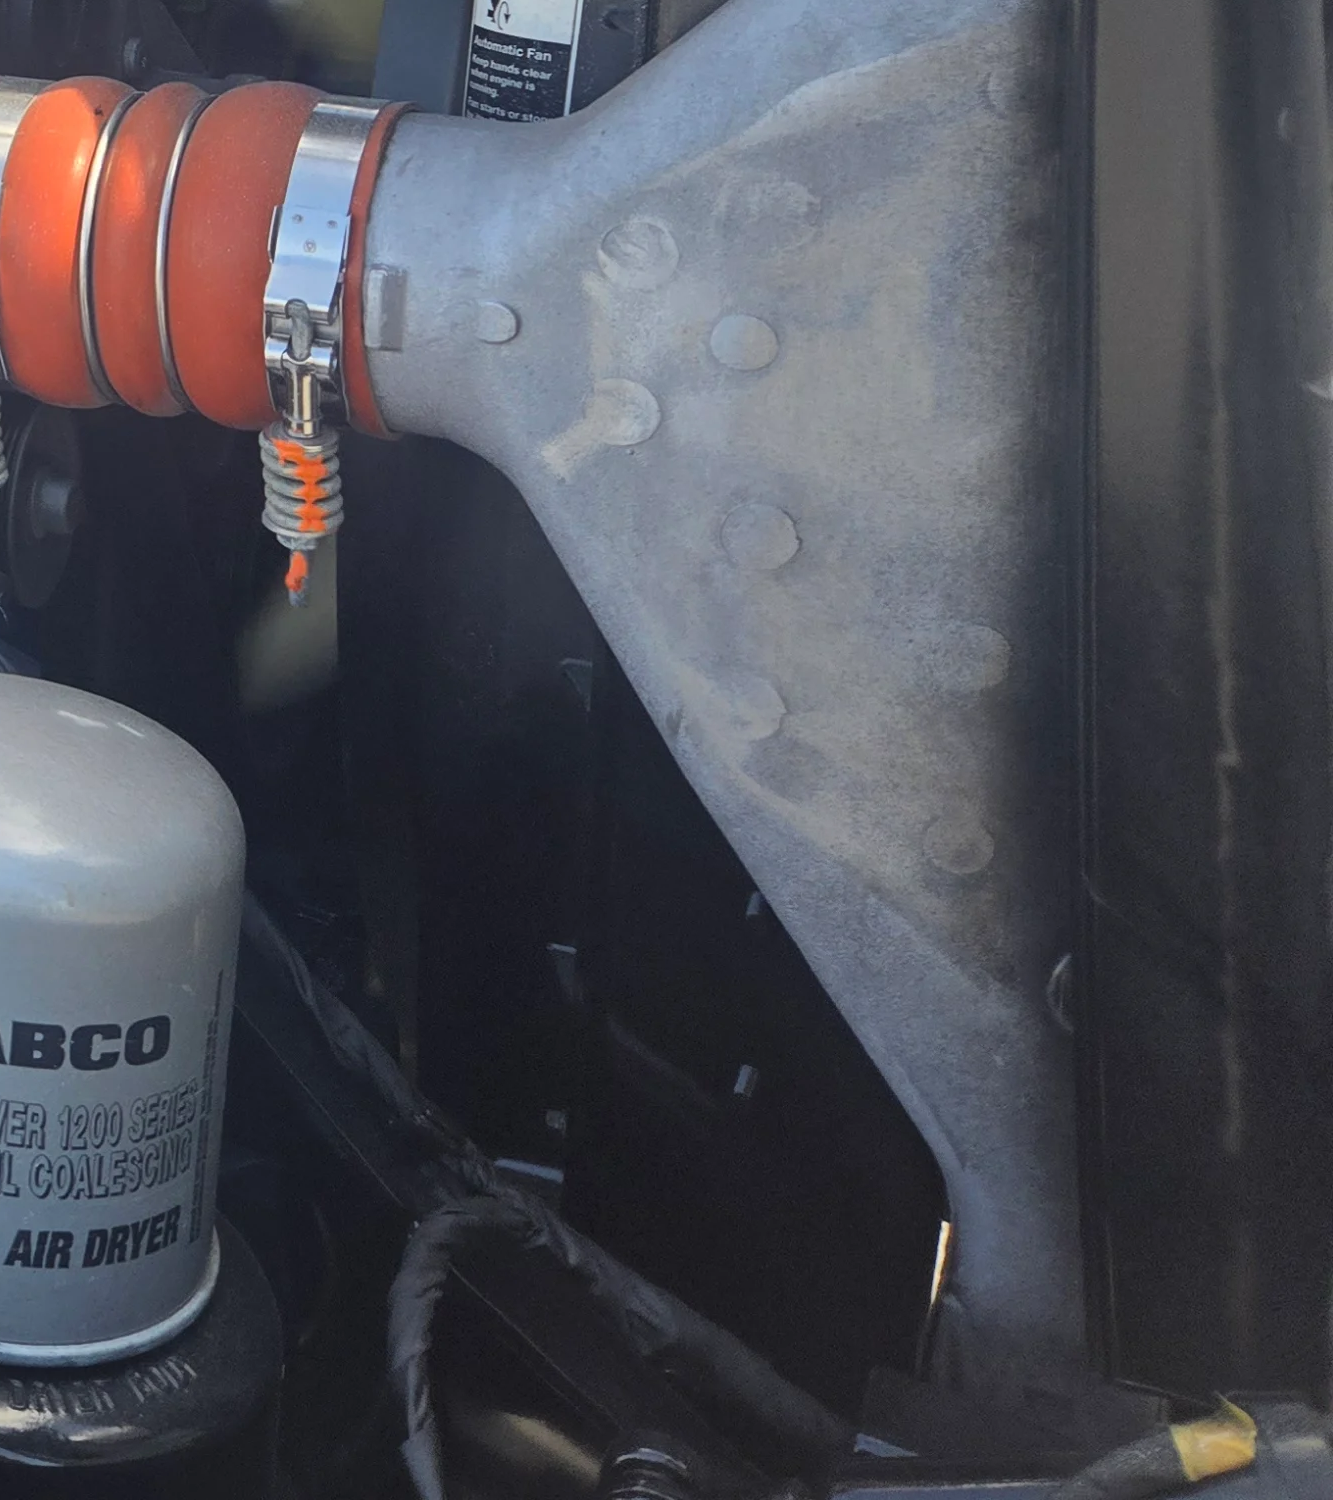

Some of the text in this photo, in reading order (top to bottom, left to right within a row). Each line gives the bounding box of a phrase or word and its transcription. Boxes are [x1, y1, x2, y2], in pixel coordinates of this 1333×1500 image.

[473, 34, 552, 61] Automatic Fan
[489, 75, 523, 89] engine
[525, 80, 536, 91] is
[490, 60, 520, 75] hands
[522, 68, 553, 80] clear
[480, 103, 506, 117] starts
[507, 111, 520, 119] or
[58, 1101, 124, 1151] 1200
[127, 1077, 200, 1145] SERIES
[28, 1128, 194, 1200] COALESCING
[3, 1205, 182, 1269] AIR DRYER
